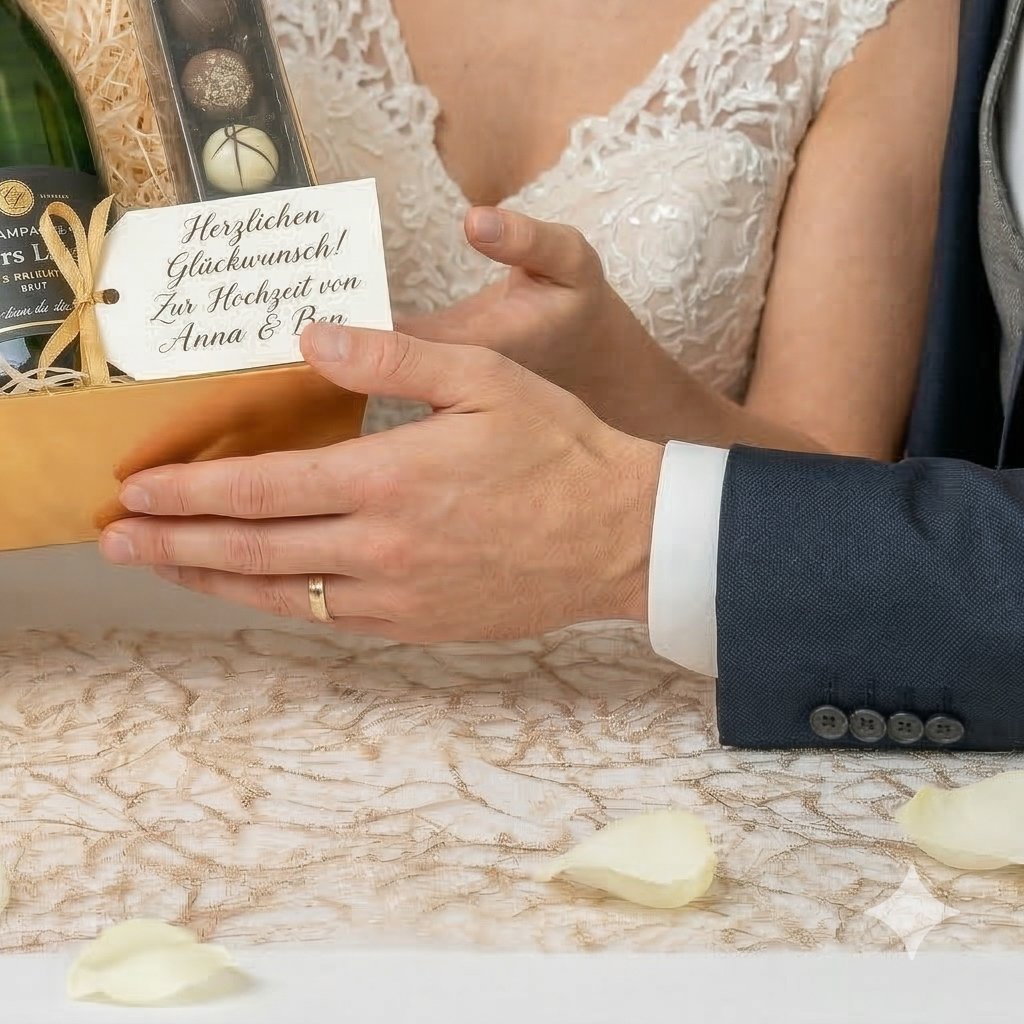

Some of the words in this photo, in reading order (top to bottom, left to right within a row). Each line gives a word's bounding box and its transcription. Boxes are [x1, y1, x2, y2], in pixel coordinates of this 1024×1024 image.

[181, 202, 324, 246] Herzlichen
[166, 229, 348, 290] Glückwunsch!
[20, 281, 48, 293] BRUT
[150, 291, 197, 325] Zur
[207, 275, 312, 313] Hochzeit
[319, 275, 362, 296] von
[158, 321, 248, 354] Anna
[258, 313, 282, 341] &
